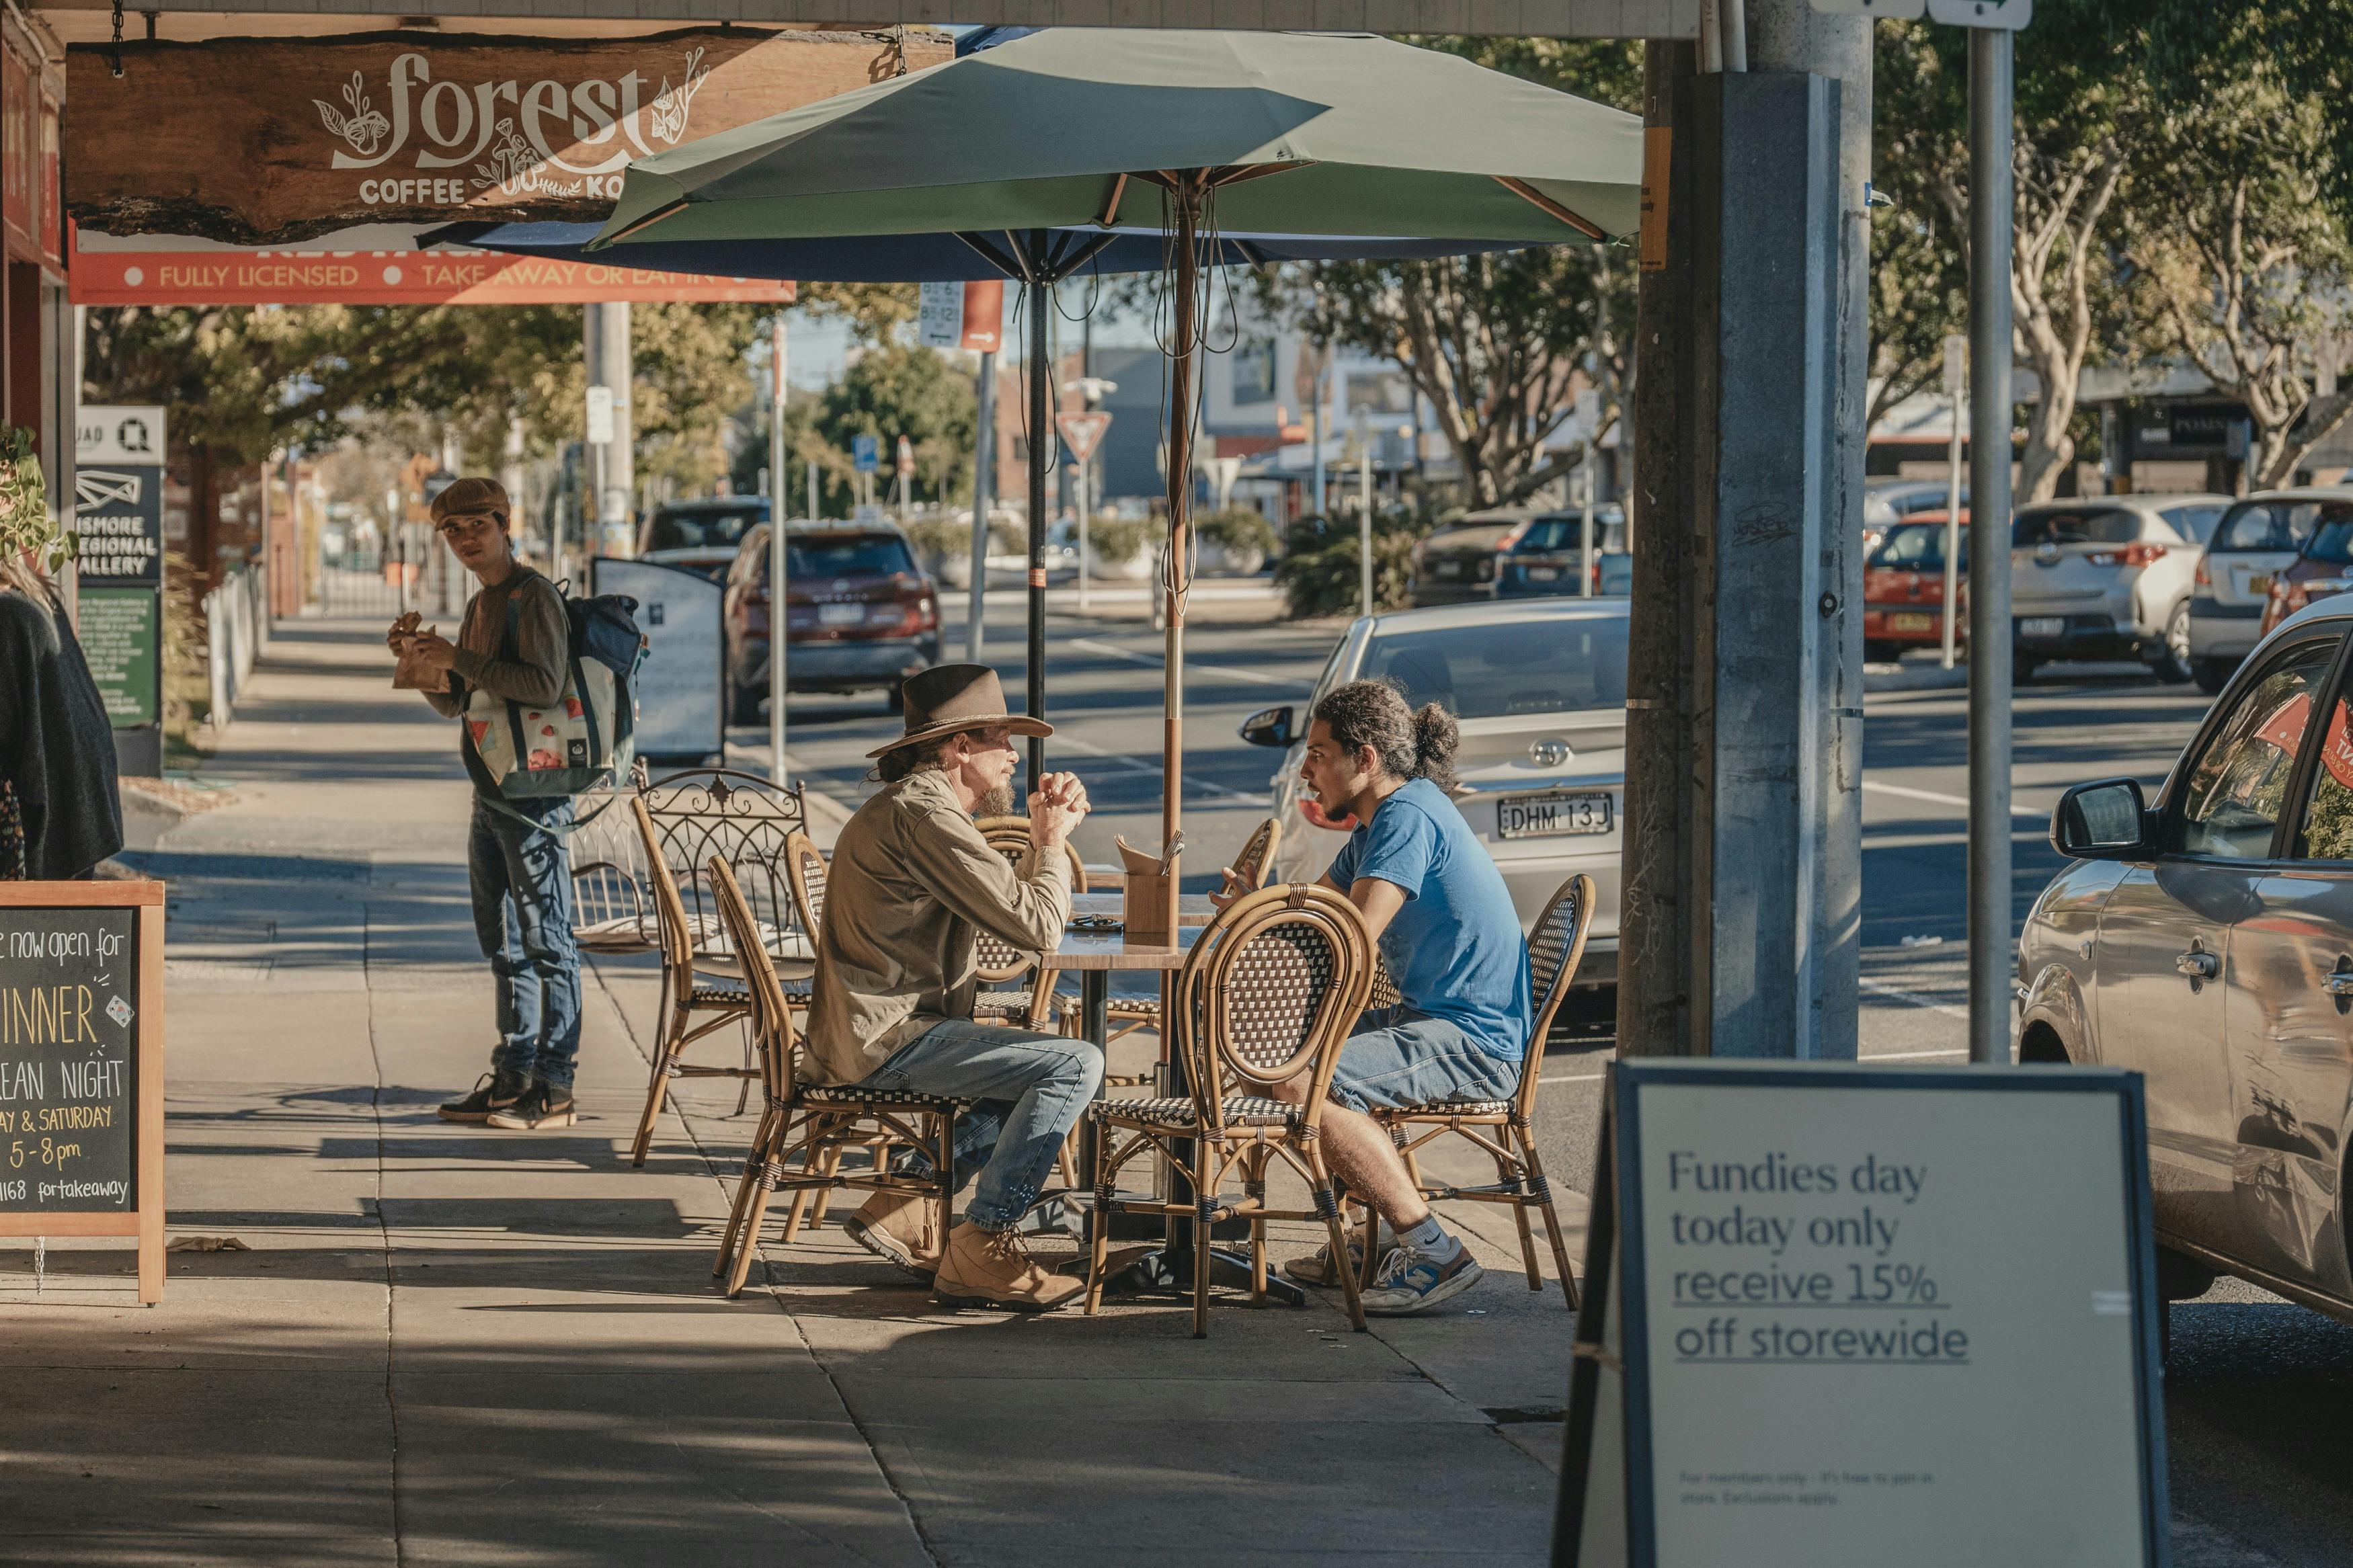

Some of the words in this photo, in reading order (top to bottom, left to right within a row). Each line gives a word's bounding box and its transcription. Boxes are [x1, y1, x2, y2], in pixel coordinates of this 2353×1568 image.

[331, 53, 655, 173] forest
[360, 178, 465, 204] COFFEE
[160, 265, 229, 287] FULLY
[238, 265, 358, 287] LICENSED
[423, 265, 486, 286] TAKE
[494, 264, 576, 286] AWAY
[585, 266, 625, 286] OR
[11, 932, 44, 958] now
[48, 932, 89, 966] open
[95, 927, 124, 967] for
[0, 1061, 44, 1100] EAN
[61, 1060, 124, 1099] NIGHT
[22, 1110, 36, 1132] &
[39, 1106, 111, 1131] SATURDAY
[1669, 1151, 1839, 1194] Fundies
[1850, 1153, 1927, 1204] day
[1671, 1206, 1796, 1255] today
[1808, 1206, 1900, 1257] only
[1673, 1263, 1833, 1302] receive
[1847, 1263, 1938, 1303] 15%
[1675, 1318, 1737, 1356] off
[1751, 1319, 1968, 1358] storewide
